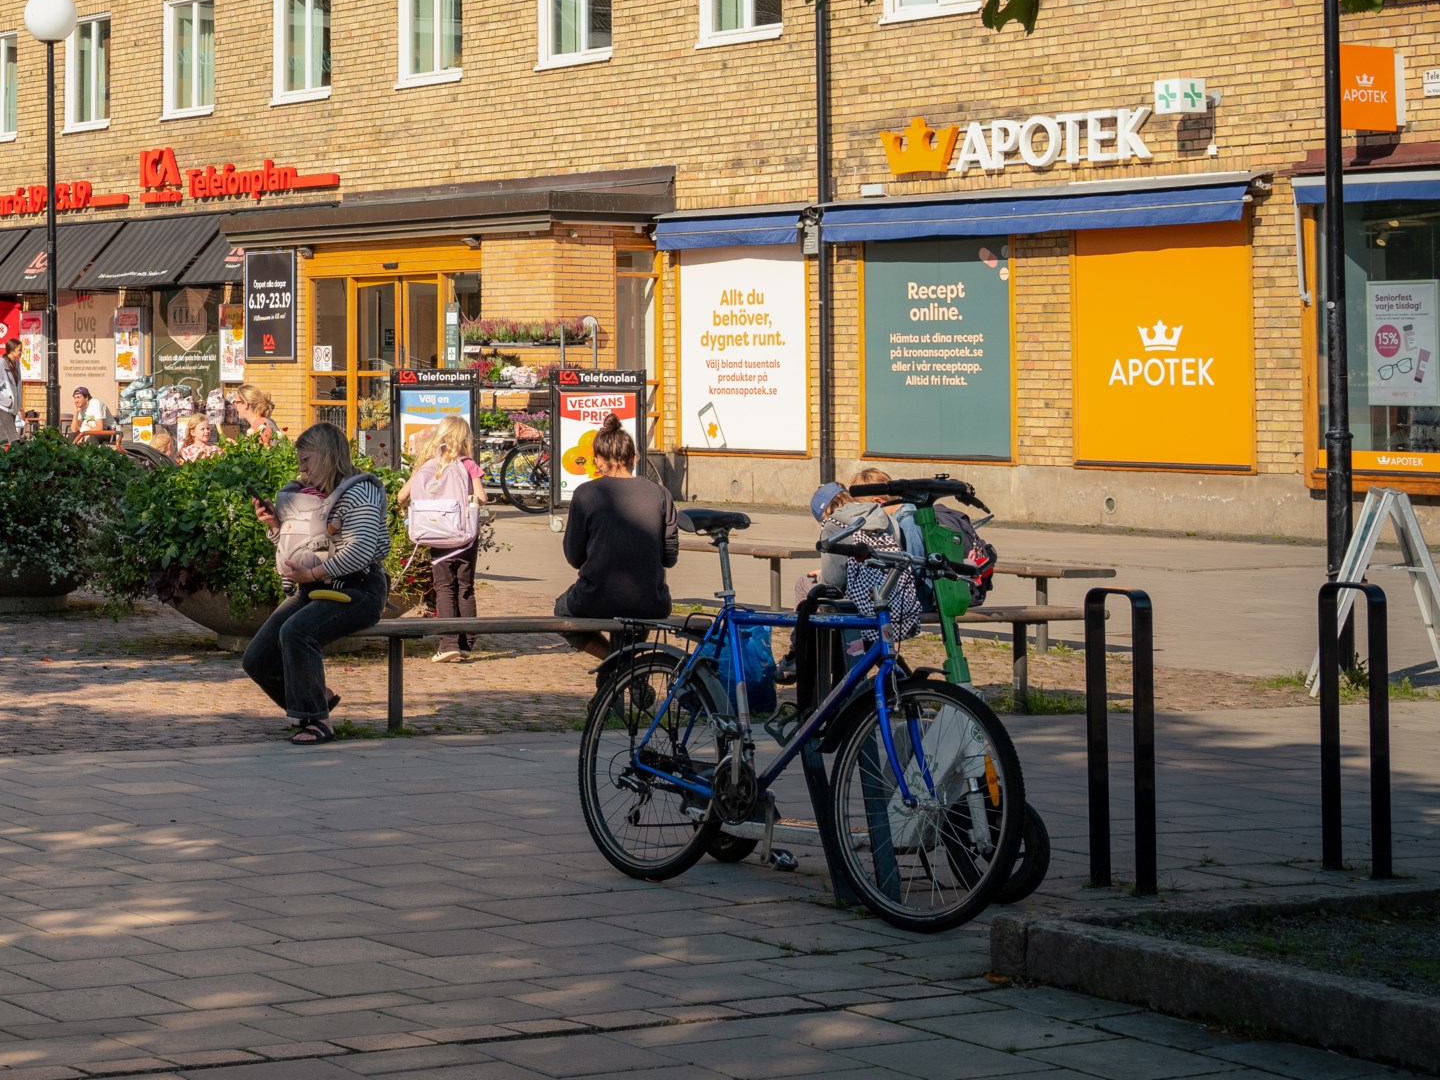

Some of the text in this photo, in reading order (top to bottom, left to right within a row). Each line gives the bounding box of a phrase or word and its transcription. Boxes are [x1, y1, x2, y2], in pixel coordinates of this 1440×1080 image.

[1343, 88, 1388, 103] APOTEK
[956, 107, 1152, 172] APOTEK
[140, 147, 182, 188] ICA
[186, 160, 297, 200] Telefonplan
[13, 180, 92, 213] 6.19-3.19
[29, 251, 48, 268] IC
[253, 280, 266, 290] Öppet
[274, 280, 287, 289] dagar
[907, 281, 966, 303] Recept
[249, 291, 292, 309] 6.19-23.19
[720, 289, 764, 306] Allt du
[1375, 294, 1412, 302] Seniorfest
[910, 302, 963, 321] online.
[1375, 302, 1422, 311] varje tisdag!
[74, 312, 97, 332] love
[713, 309, 772, 328] behöver,
[74, 335, 97, 354] eco!
[263, 333, 275, 346] ICA
[700, 330, 786, 351] dygnet runt.
[890, 333, 984, 345] Hämta ut dina recept
[1377, 332, 1399, 345] 15%
[890, 346, 983, 360] på kronansapotek.se
[706, 359, 780, 371] Välj bland tusentals
[892, 361, 911, 371] eller
[917, 360, 931, 371] vår
[932, 362, 982, 374] receptapp.
[1108, 358, 1215, 386] APOTEK
[399, 371, 471, 382] ICA Telefonplan
[560, 371, 637, 384] ICA Telefonplan
[718, 371, 768, 384] produkter på
[905, 375, 968, 385] Alltid fri frakt.
[709, 386, 778, 397] kronansapotek.se
[419, 394, 436, 405] Välj
[569, 396, 624, 409] VECKANS
[582, 410, 609, 422] PRIS
[1391, 456, 1423, 466] APOTEK
